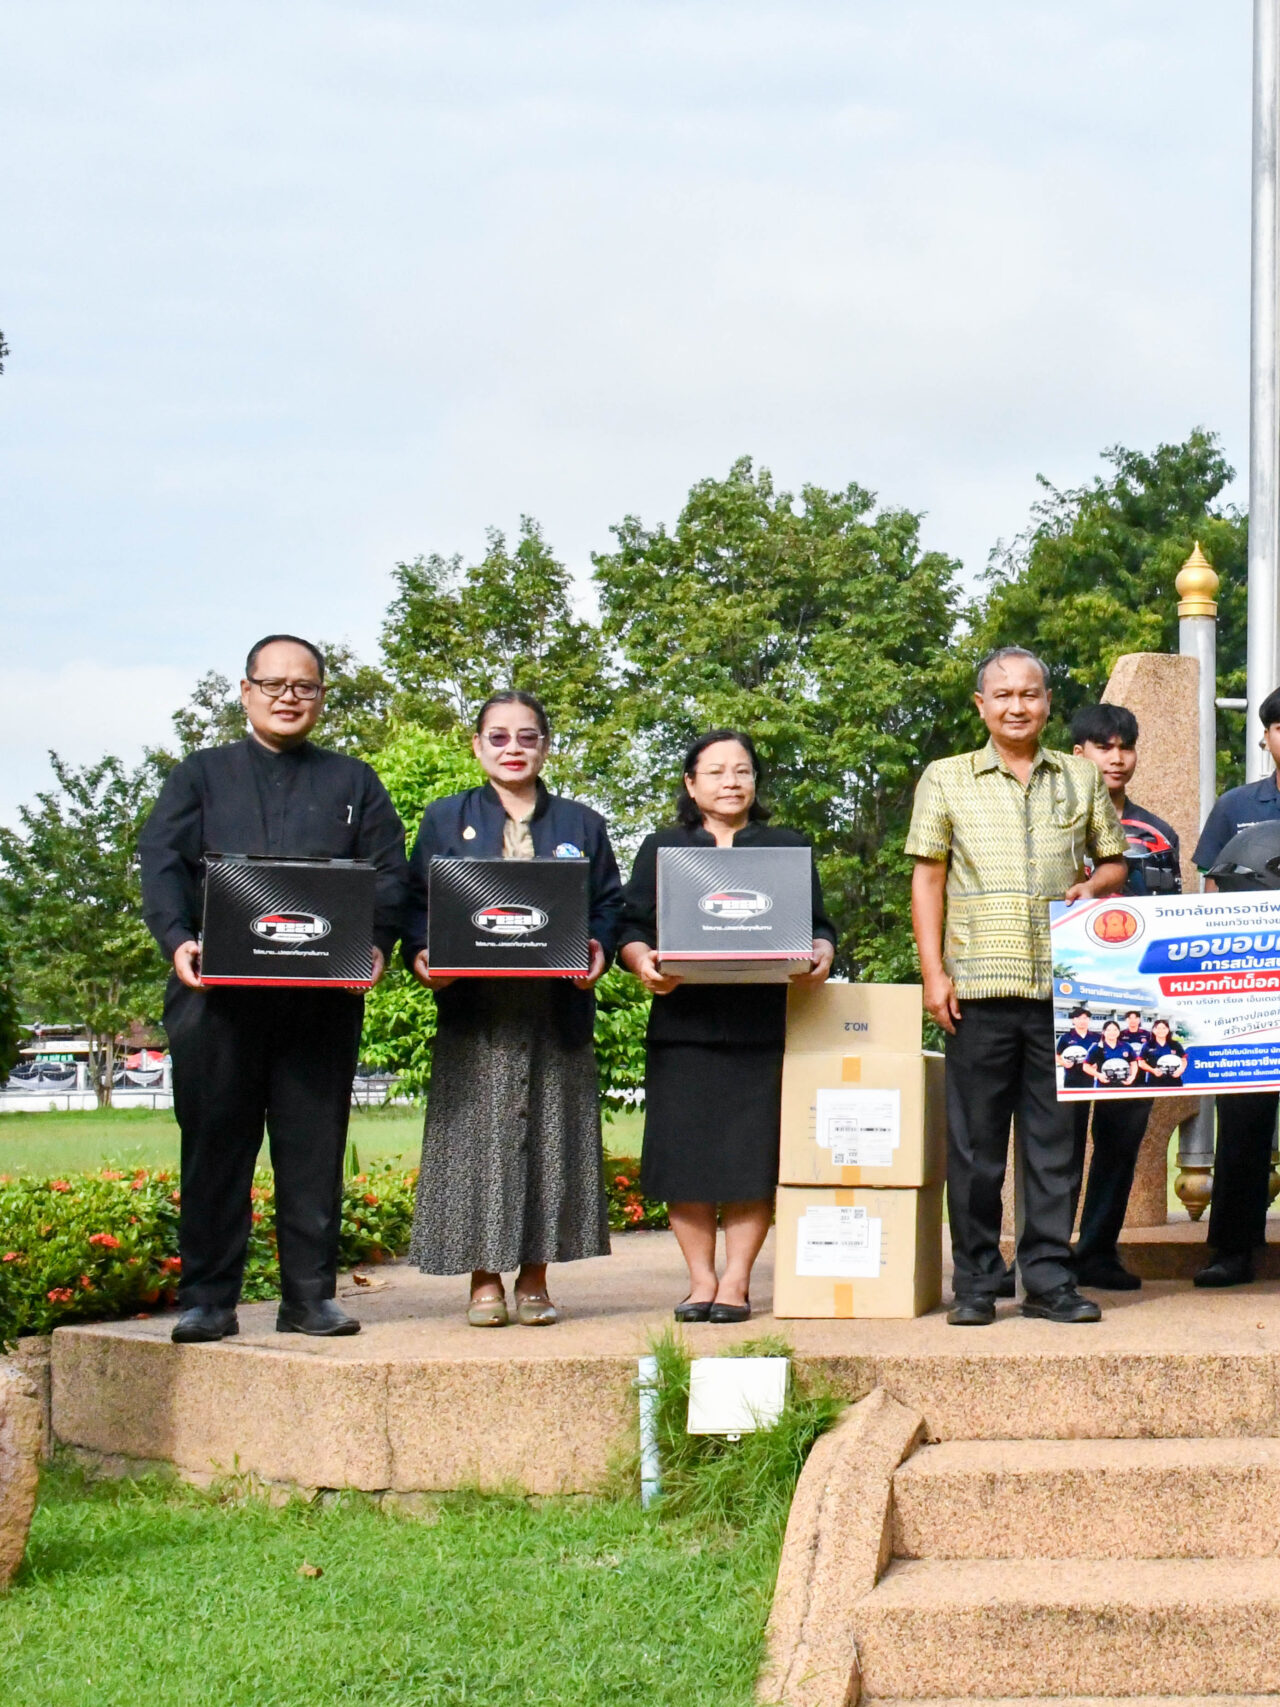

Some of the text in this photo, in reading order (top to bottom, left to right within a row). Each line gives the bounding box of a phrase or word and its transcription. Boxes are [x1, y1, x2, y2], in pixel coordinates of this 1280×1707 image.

[1170, 973, 1280, 993] หมวกกันน็อค
[1196, 996, 1221, 1005] บริษัท
[844, 1022, 869, 1032] NO.2
